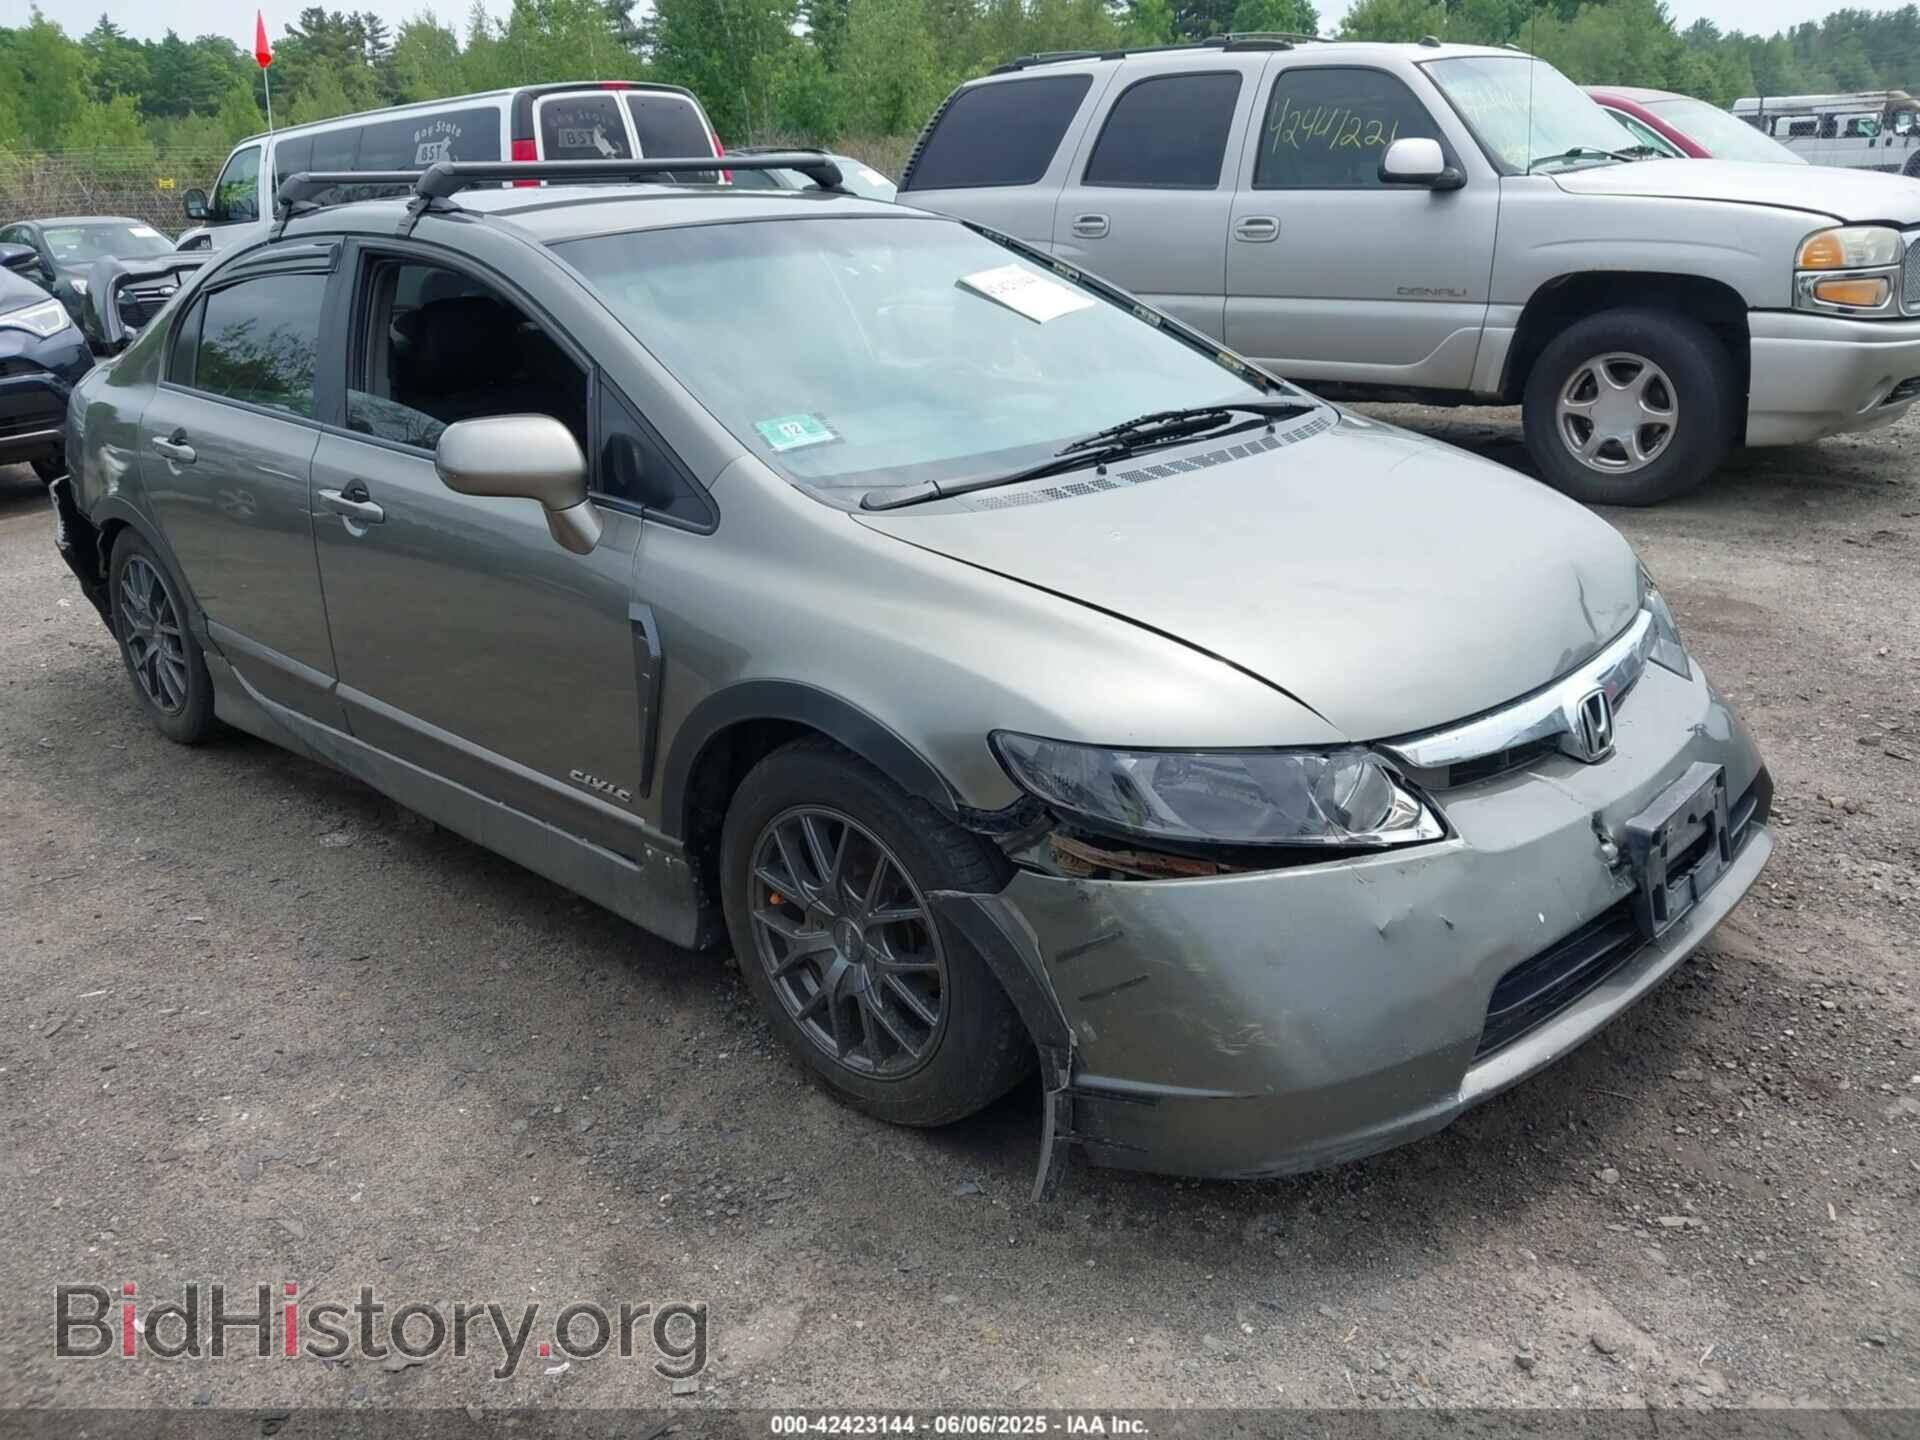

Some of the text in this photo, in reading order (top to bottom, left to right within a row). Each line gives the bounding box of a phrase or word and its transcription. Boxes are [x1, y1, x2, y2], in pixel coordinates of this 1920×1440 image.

[420, 144, 442, 161] BST
[1396, 286, 1467, 298] DENALI
[569, 769, 632, 802] CIVIC
